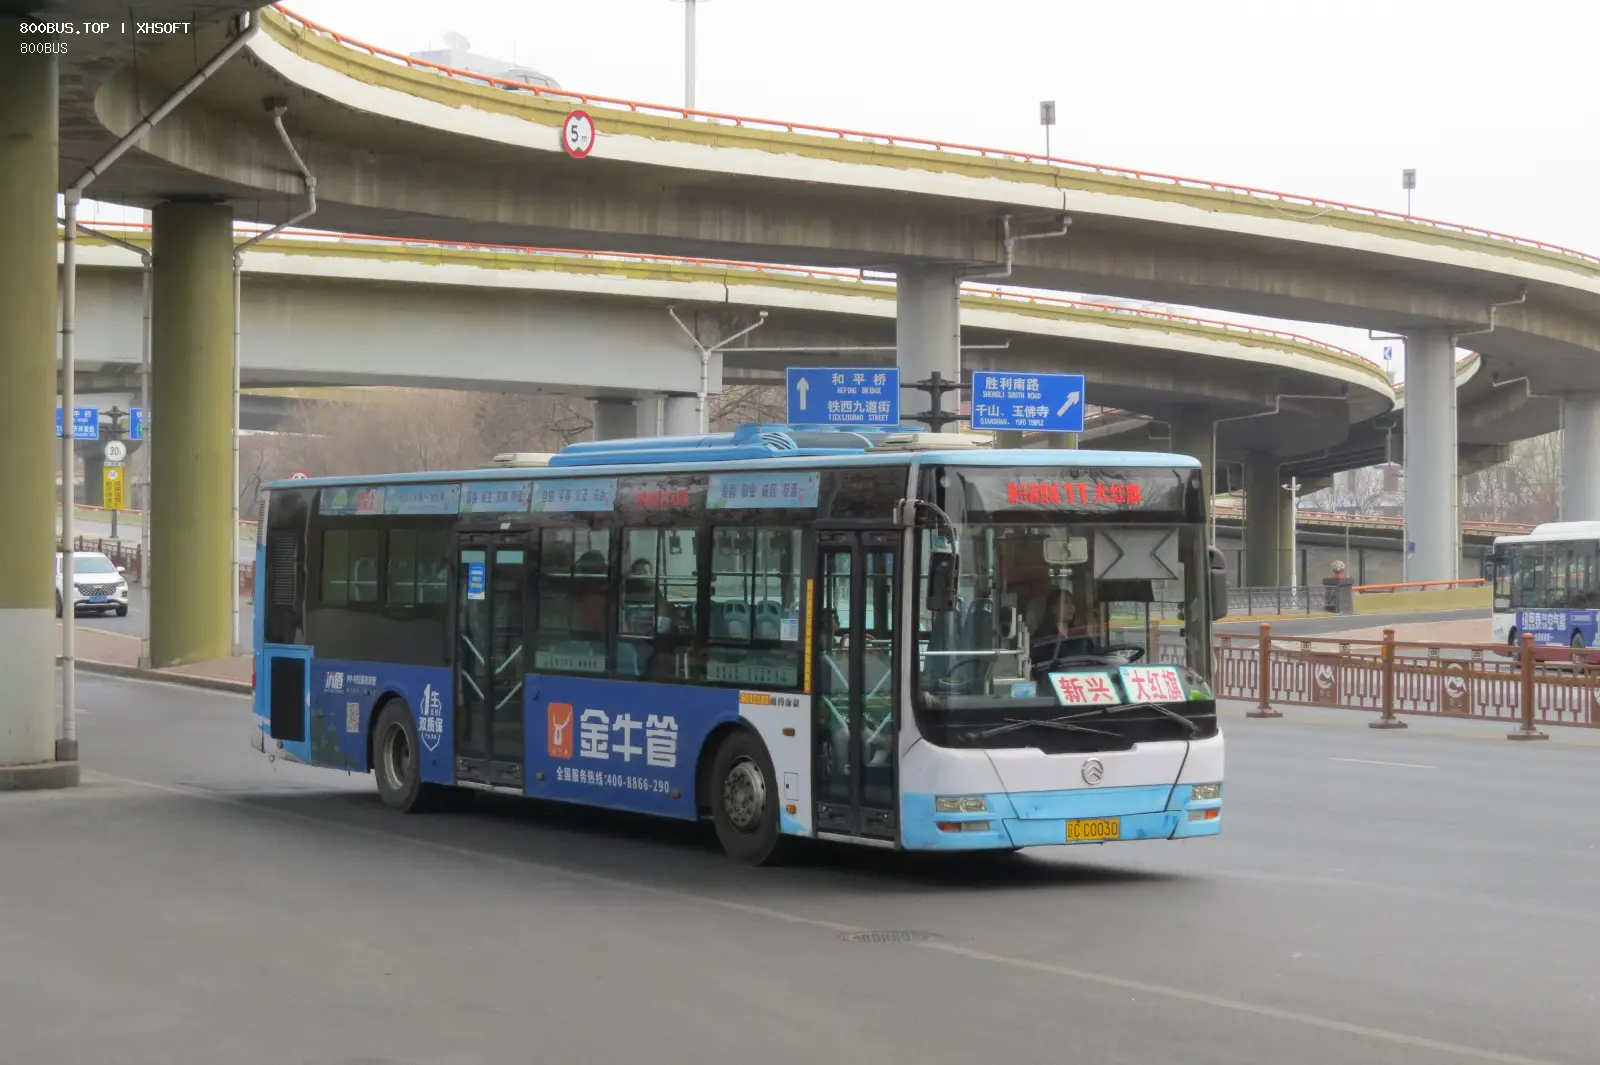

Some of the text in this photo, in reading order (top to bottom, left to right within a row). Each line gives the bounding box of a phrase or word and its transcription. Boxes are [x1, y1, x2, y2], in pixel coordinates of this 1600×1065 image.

[831, 373, 887, 386] 和平桥
[985, 376, 1040, 391] 胜利南路
[982, 390, 1042, 400] SHENGLI SOUTH ROAD
[827, 400, 891, 414] 铁西九道街
[868, 414, 889, 422] STREET
[1028, 419, 1045, 427] TEMPLE
[1063, 481, 1089, 505] 11
[1093, 481, 1142, 504] 大红旗
[1058, 676, 1116, 704] 新兴
[1131, 669, 1183, 702] 大红旗
[418, 717, 443, 733] 双质保
[580, 708, 679, 768] 金牛管
